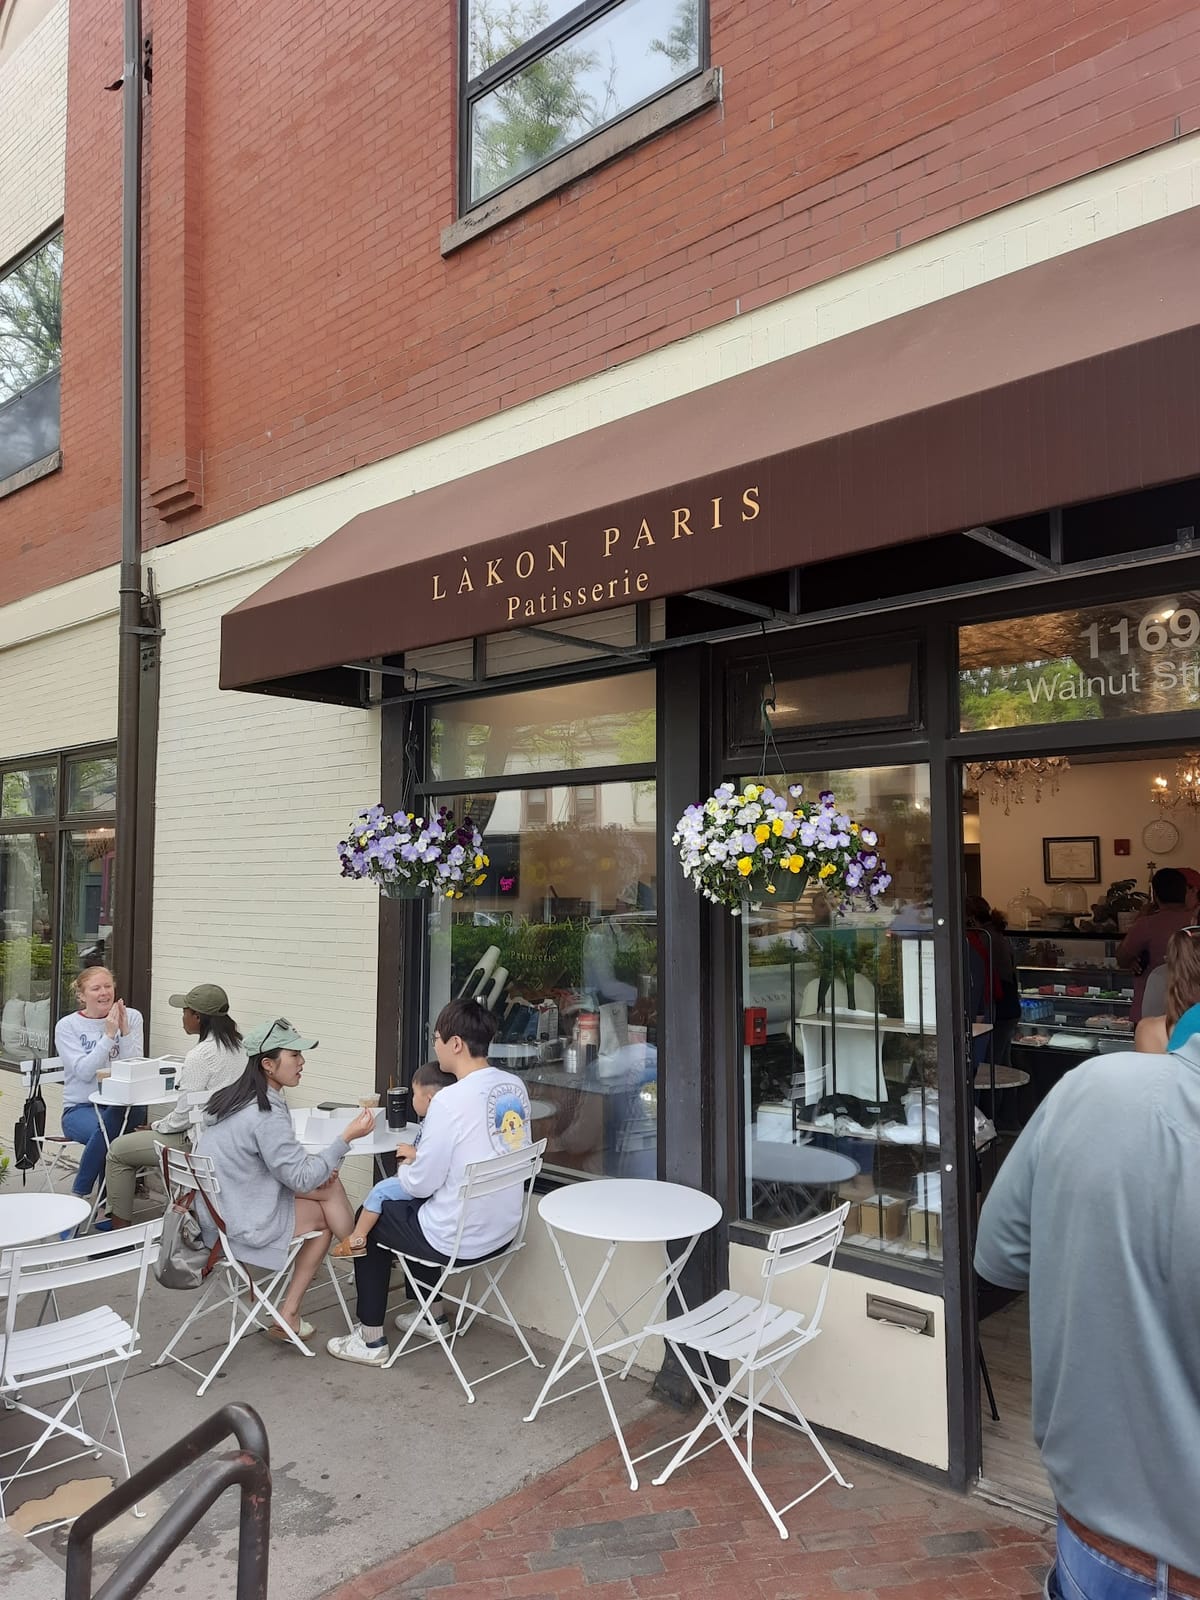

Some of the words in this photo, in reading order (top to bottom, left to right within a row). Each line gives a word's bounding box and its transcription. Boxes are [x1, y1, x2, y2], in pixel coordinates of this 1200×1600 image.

[432, 541, 568, 600] LÀKON
[603, 486, 761, 557] PARIS
[507, 569, 650, 620] Patisserie
[1080, 608, 1200, 659] 1169
[1026, 666, 1141, 704] Walnut
